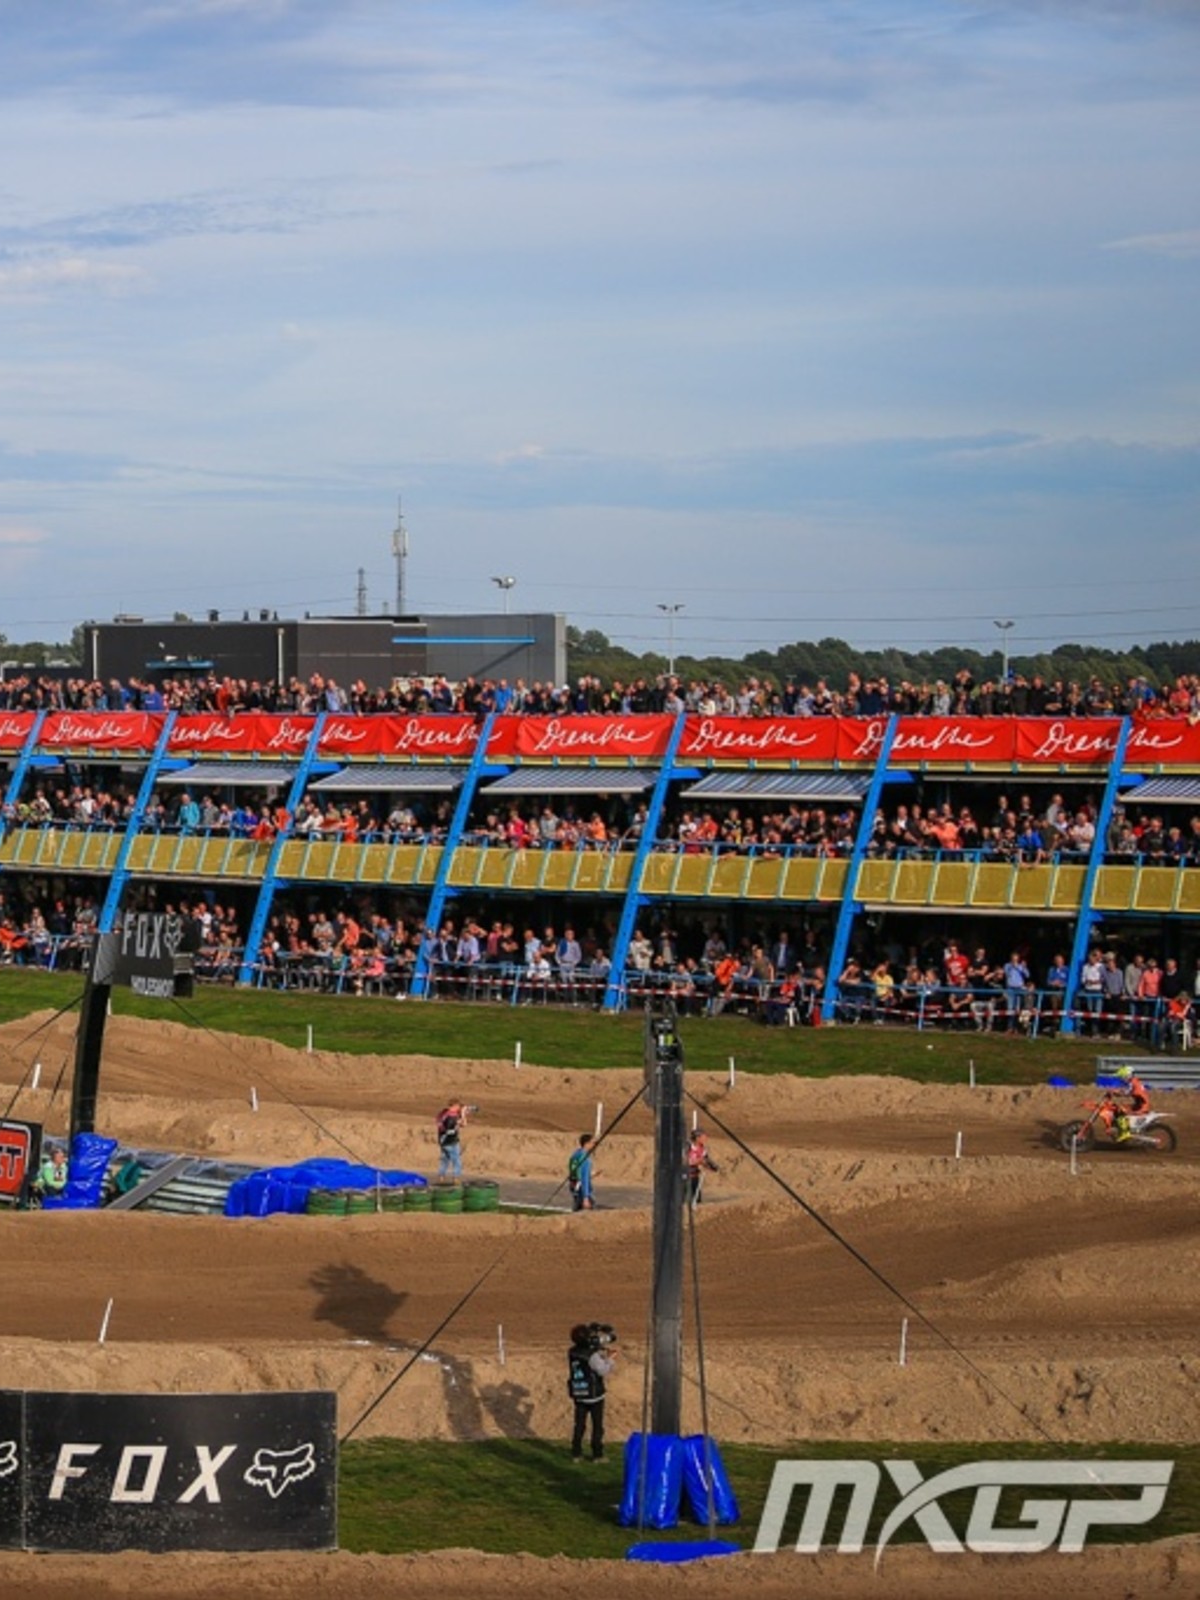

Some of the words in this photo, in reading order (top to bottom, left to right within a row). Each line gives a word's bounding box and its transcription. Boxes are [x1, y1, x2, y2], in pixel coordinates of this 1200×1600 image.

[49, 715, 132, 742] Drenthe
[166, 721, 244, 743] renthe
[268, 718, 367, 747] Drethe
[534, 719, 654, 751] Drenthe
[686, 719, 816, 751] Drenthe
[853, 721, 994, 755] Denthe
[121, 912, 163, 959] FOX
[48, 1443, 238, 1503] FOX
